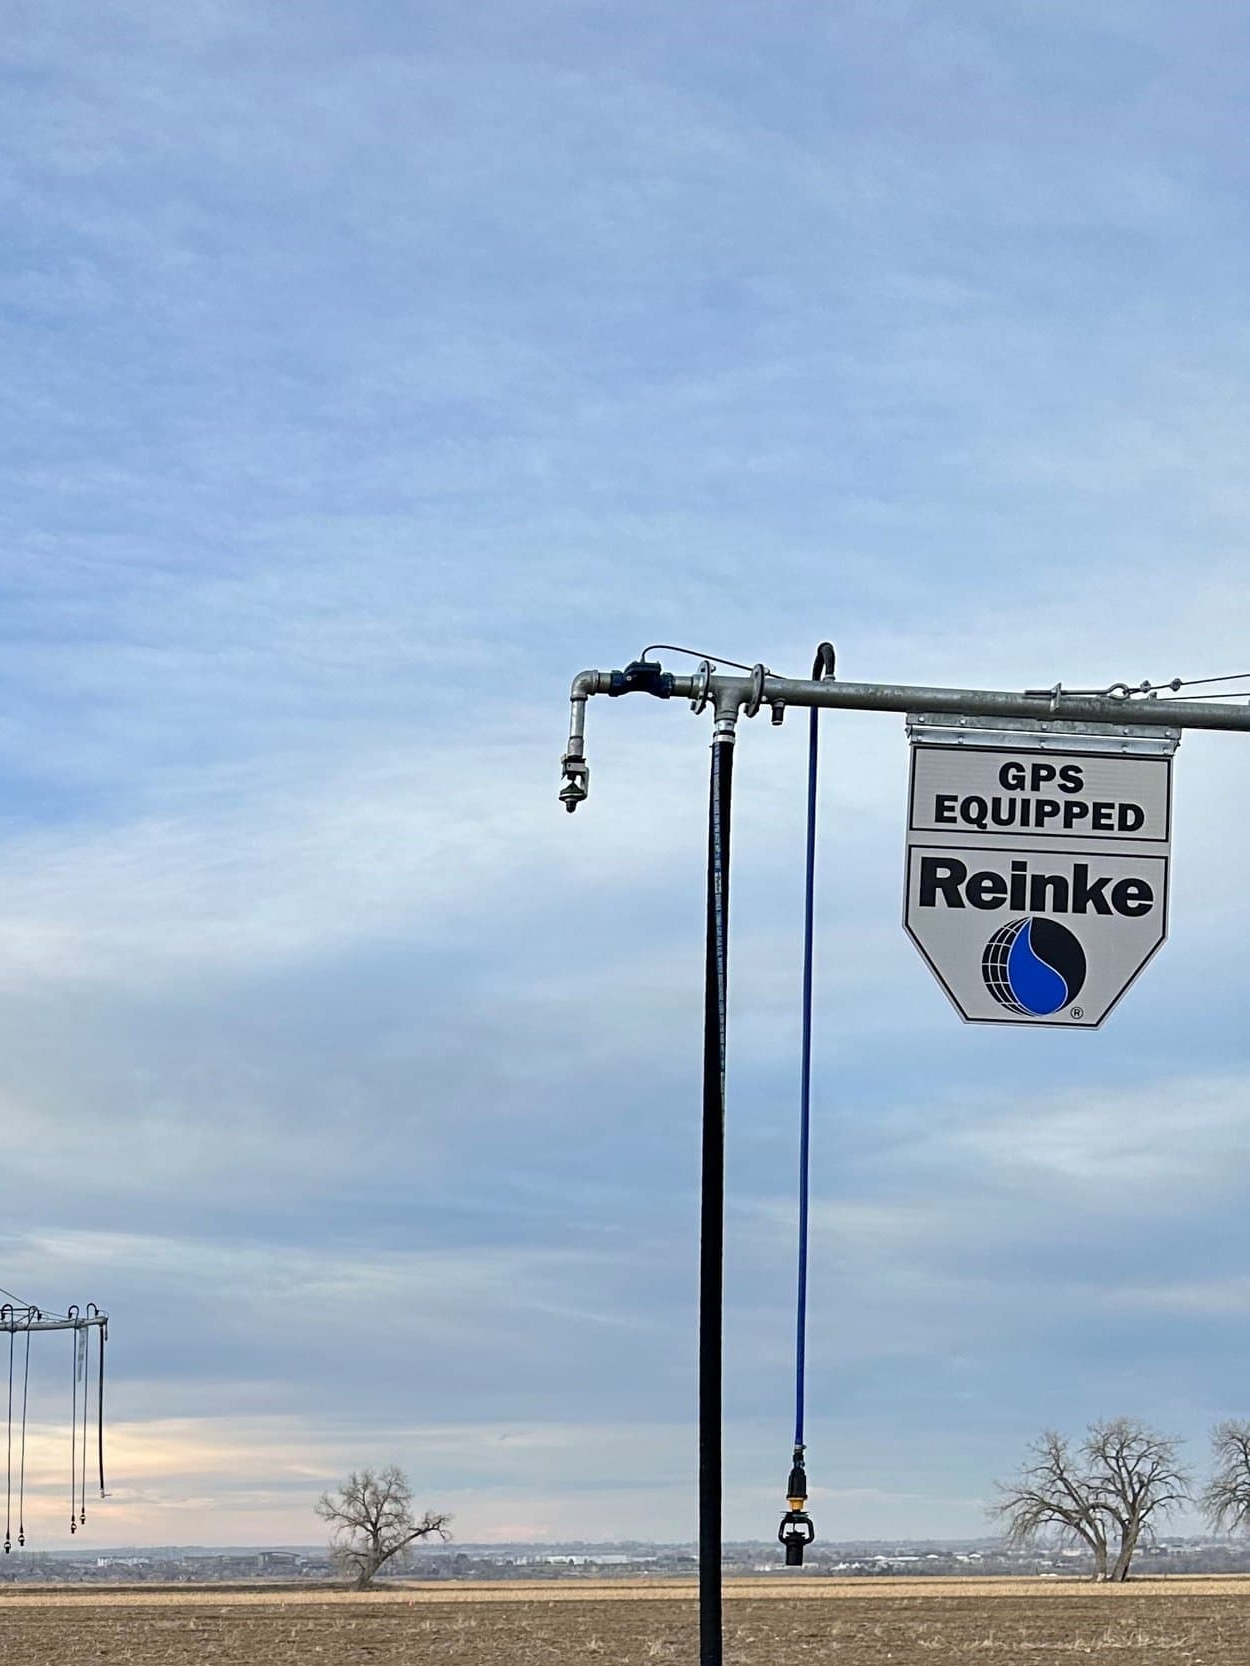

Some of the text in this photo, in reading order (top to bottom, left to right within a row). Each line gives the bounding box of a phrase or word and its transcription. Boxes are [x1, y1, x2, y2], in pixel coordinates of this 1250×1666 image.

[998, 762, 1084, 793] GPS
[934, 794, 1145, 832] EQUIPPED
[919, 856, 1154, 917] Reinke
